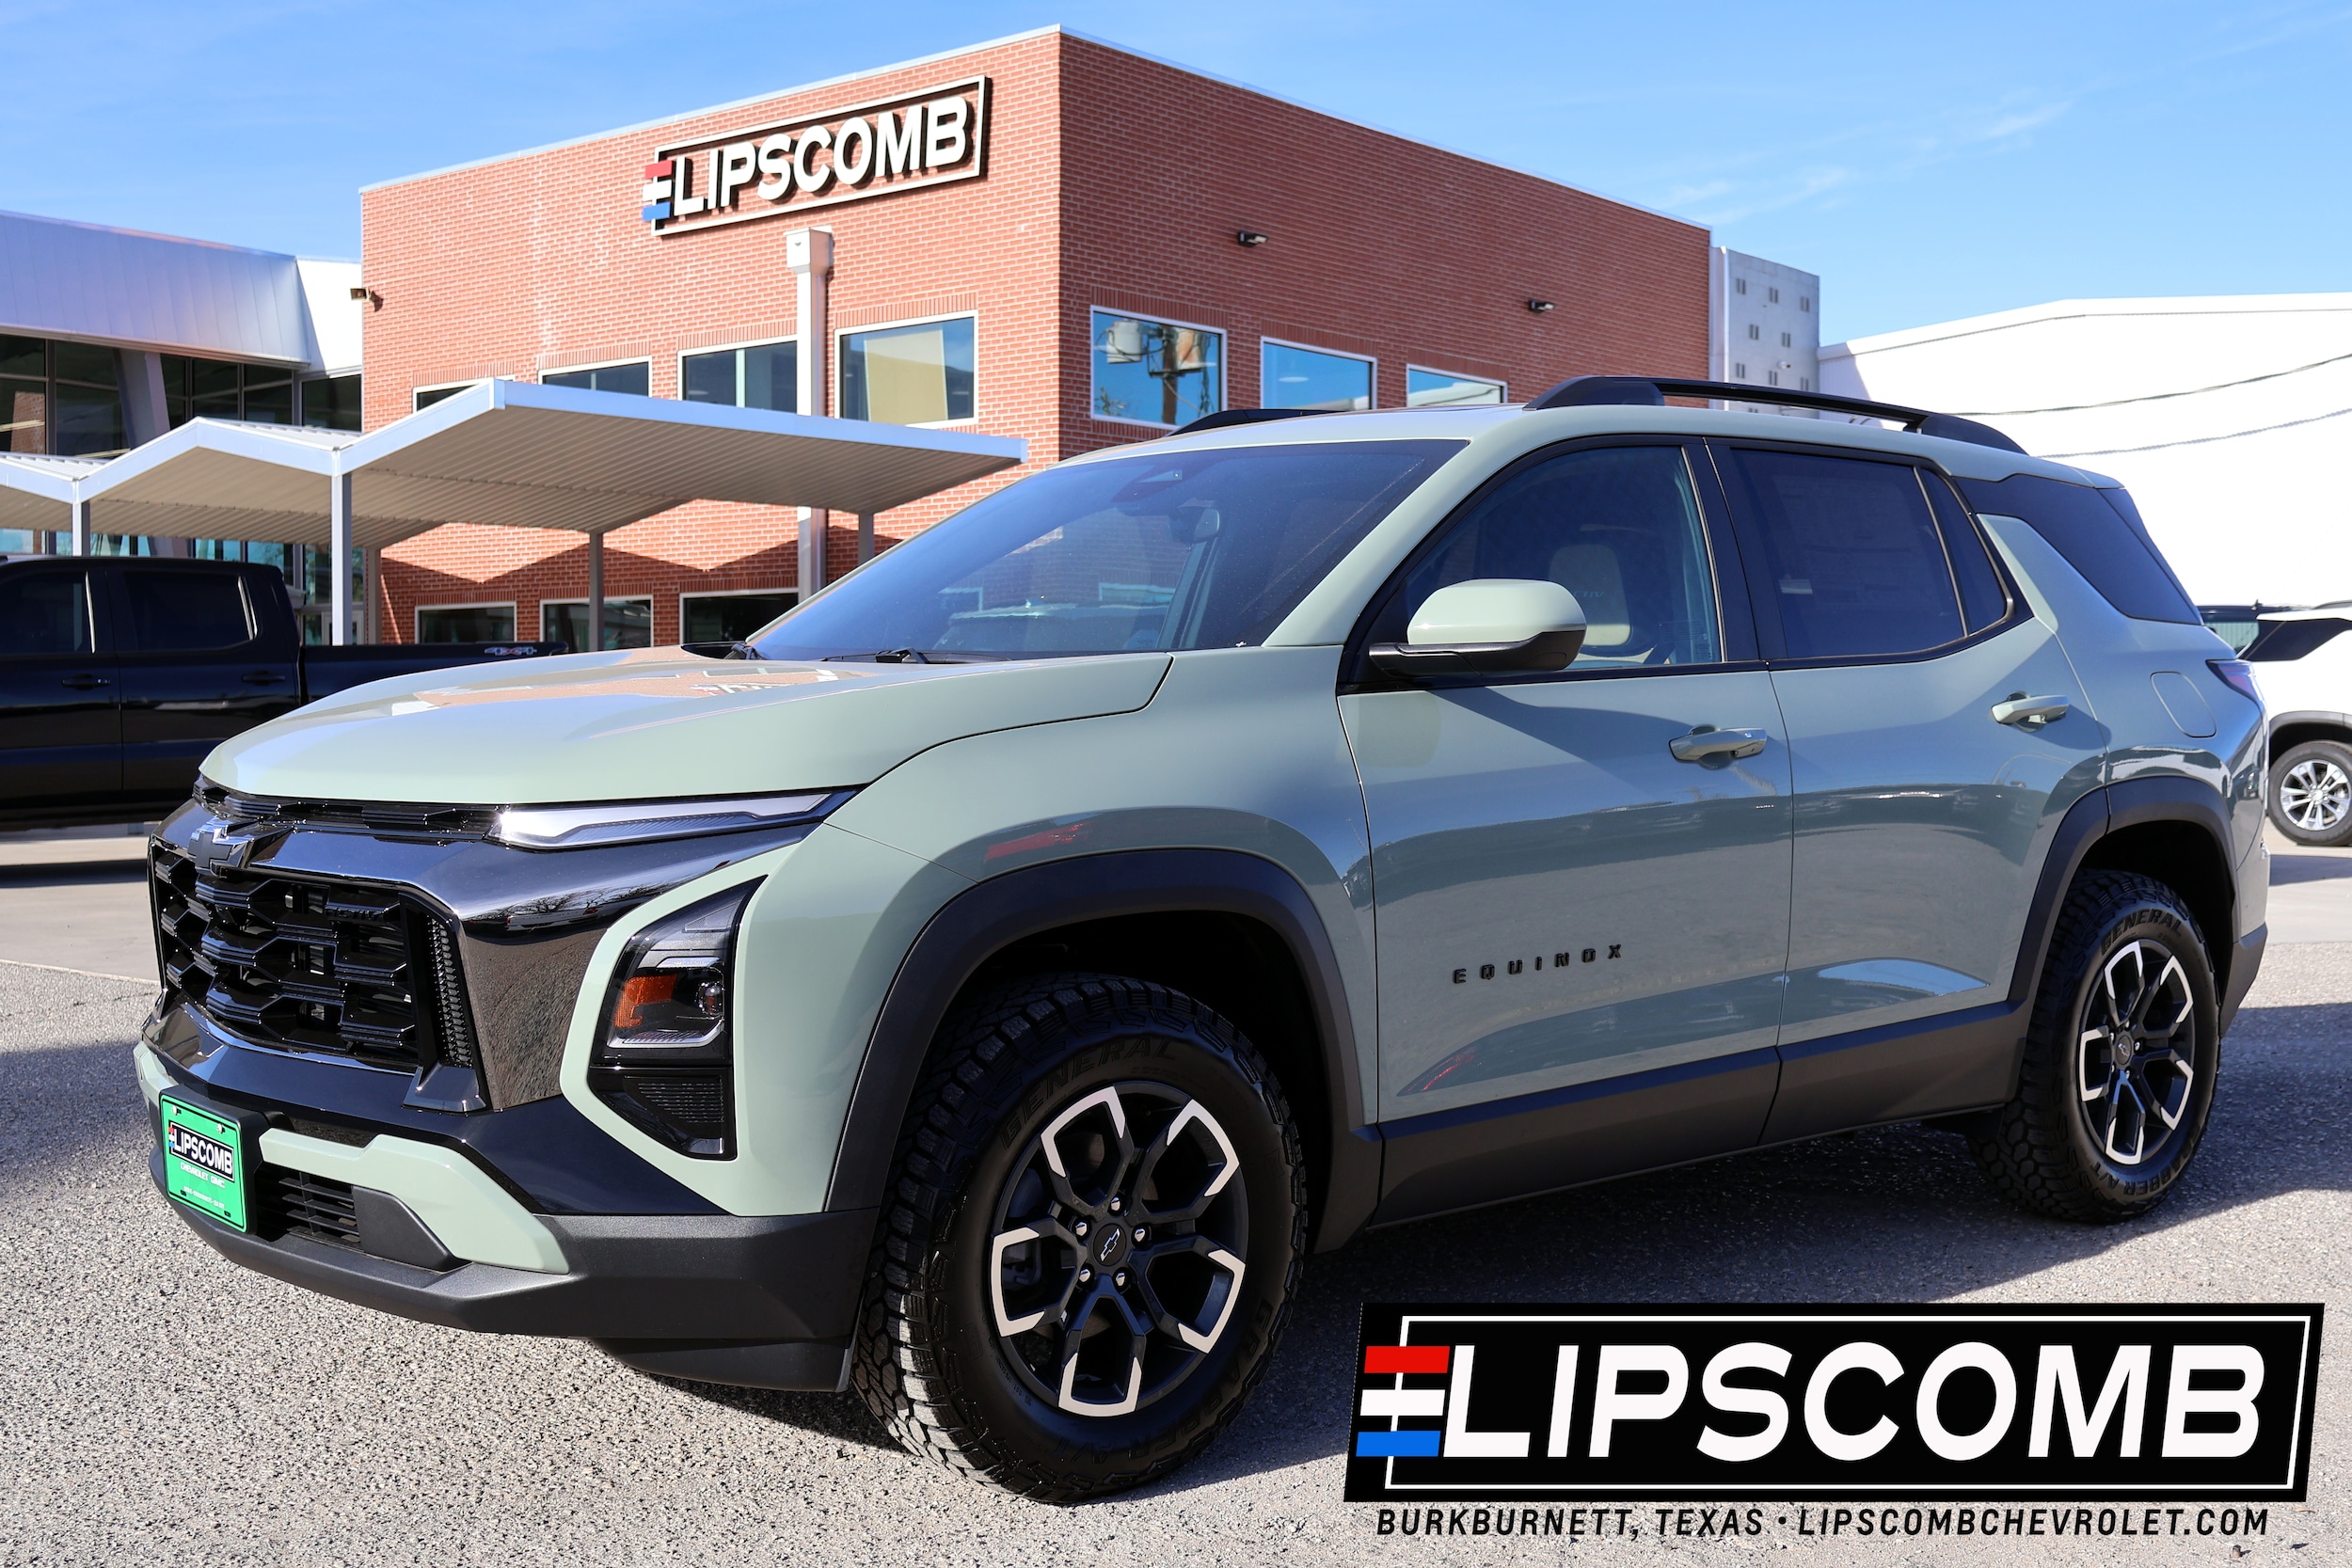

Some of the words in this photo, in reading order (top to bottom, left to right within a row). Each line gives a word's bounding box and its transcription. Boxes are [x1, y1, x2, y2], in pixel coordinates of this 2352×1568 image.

[674, 96, 971, 216] LIPSCOMB
[2101, 908, 2183, 955] GENERAL
[1453, 943, 1622, 984] EQUINOX
[1000, 1036, 1176, 1149] GENERAL
[173, 1129, 233, 1176] LIPSCOMB
[180, 1161, 209, 1181] CHEVROLET
[210, 1175, 225, 1188] GMC
